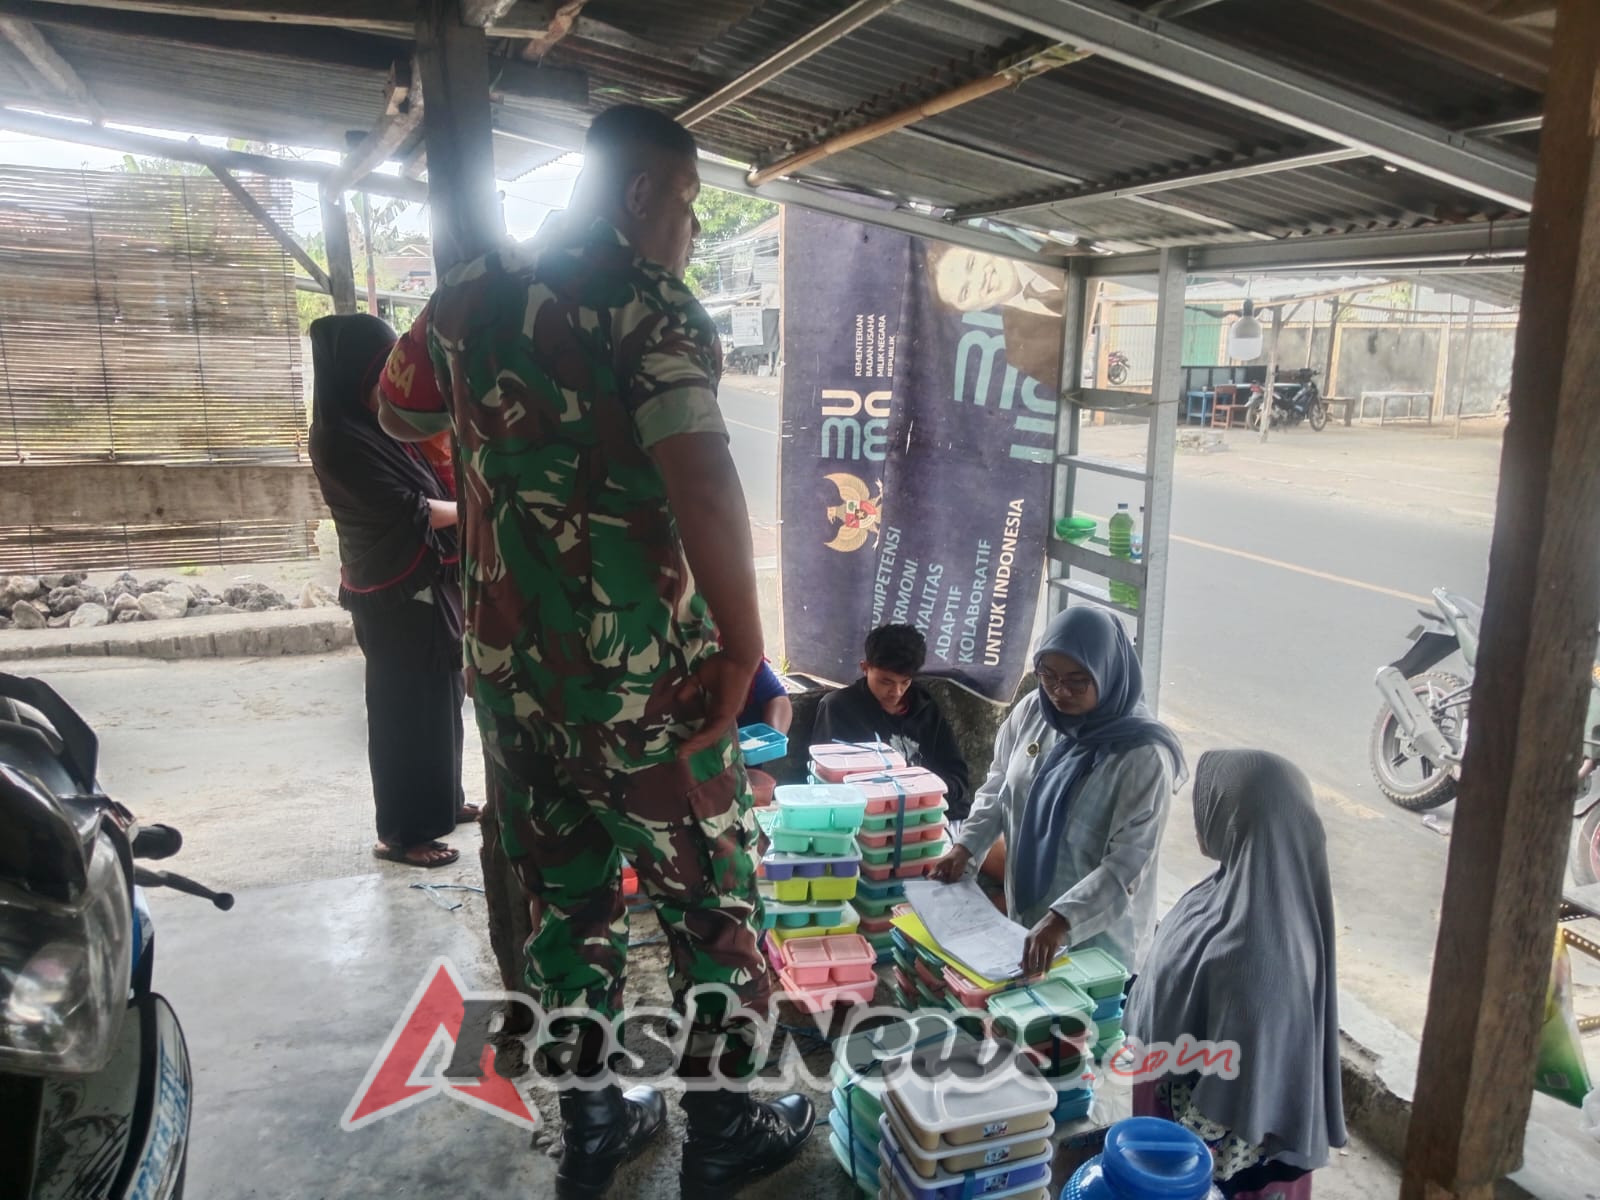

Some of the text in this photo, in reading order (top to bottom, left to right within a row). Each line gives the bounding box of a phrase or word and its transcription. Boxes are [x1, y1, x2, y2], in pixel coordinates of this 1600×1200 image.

[854, 314, 864, 377] KEMENTERIAN
[865, 313, 875, 377] BADAN USAHA
[876, 314, 886, 377] MILIK NEGARA
[871, 526, 902, 630] OMPETENSI
[890, 559, 919, 626] RMONI
[914, 563, 944, 642] YALITAS
[958, 538, 992, 664] KOLABORATIF
[983, 498, 1025, 666] UNTUK INDONESIA
[934, 585, 963, 662] ADAPTIF
